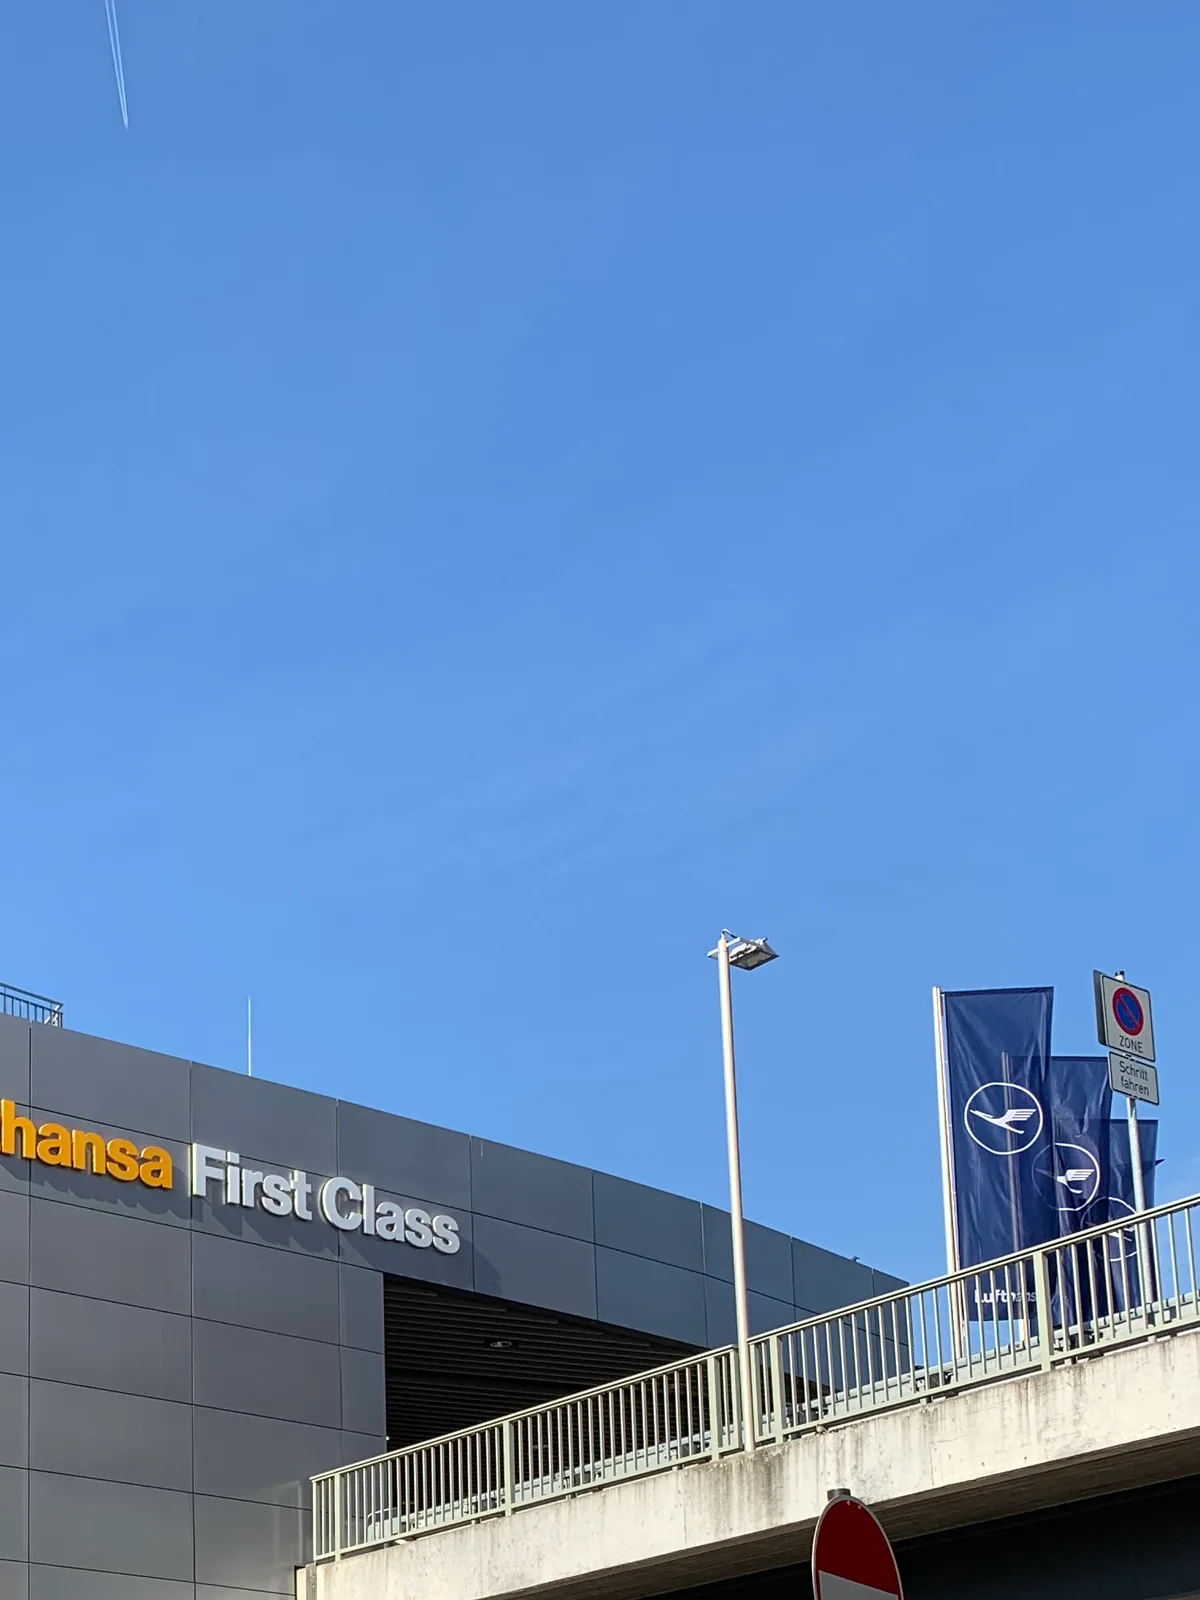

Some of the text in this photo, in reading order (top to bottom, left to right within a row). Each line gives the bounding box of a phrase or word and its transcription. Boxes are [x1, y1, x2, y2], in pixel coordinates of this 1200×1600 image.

[1119, 1034, 1143, 1053] ZONE
[1119, 1060, 1148, 1081] Schritt
[1120, 1075, 1150, 1096] fahren
[191, 1142, 314, 1222] First
[321, 1175, 461, 1255] Class
